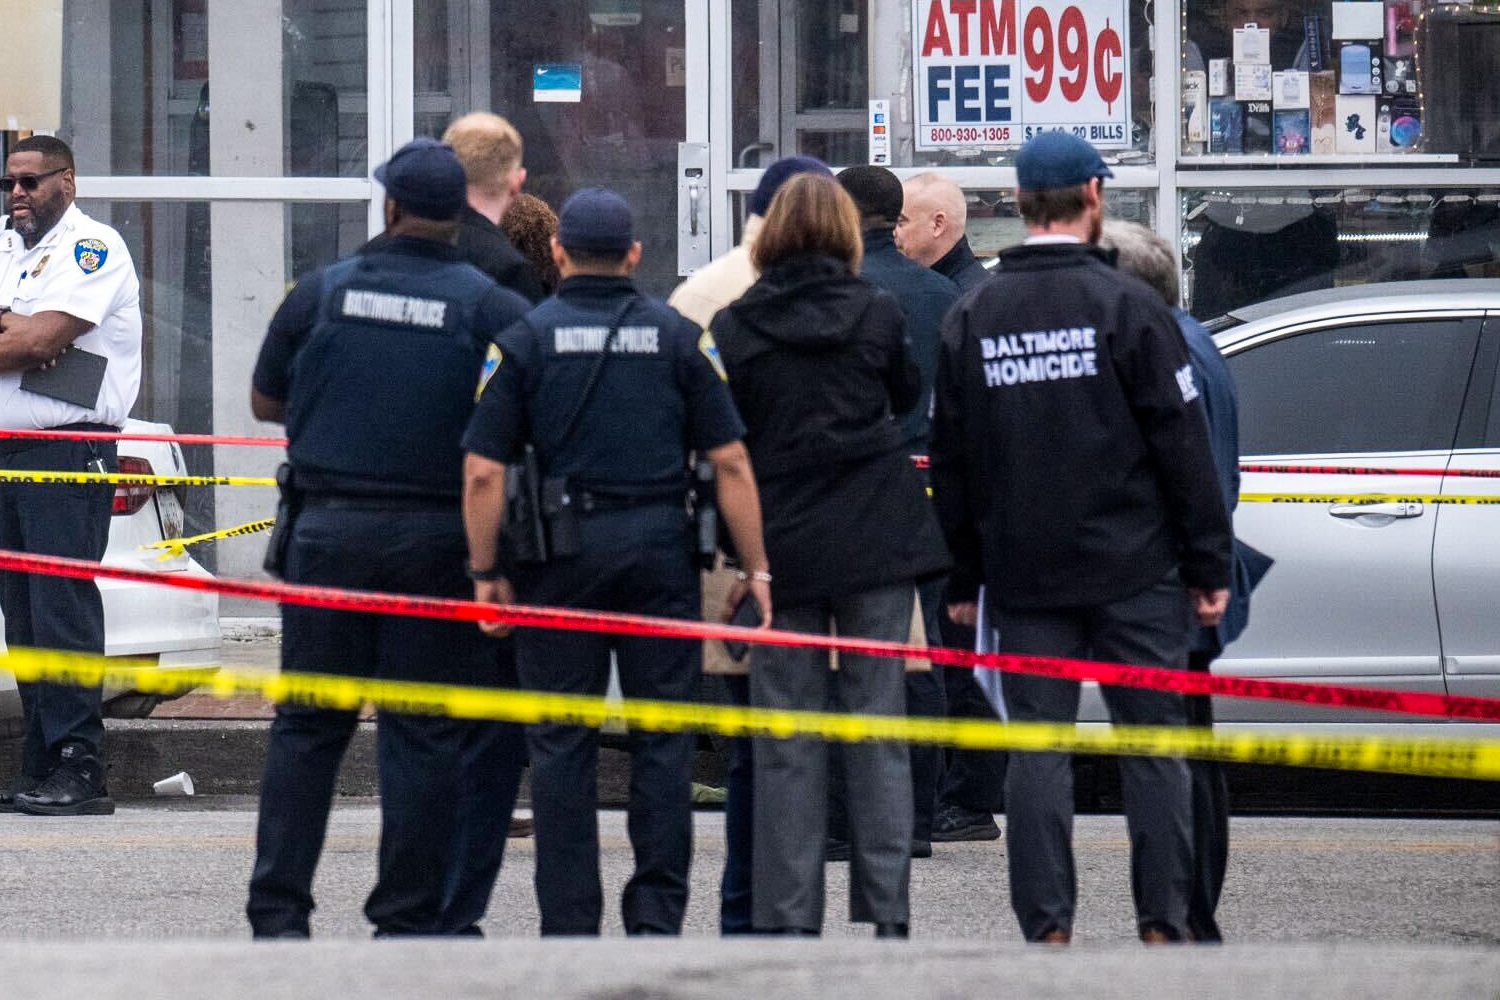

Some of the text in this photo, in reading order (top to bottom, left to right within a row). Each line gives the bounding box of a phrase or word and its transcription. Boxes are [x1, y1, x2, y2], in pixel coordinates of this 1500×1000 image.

[1023, 5, 1123, 117] 99¢
[927, 64, 1012, 123] FEE
[930, 126, 1010, 142] 800-930-1305
[1090, 124, 1123, 140] BILLS
[979, 326, 1097, 359] BALTIMORE
[983, 351, 1099, 388] HOMICIDE
